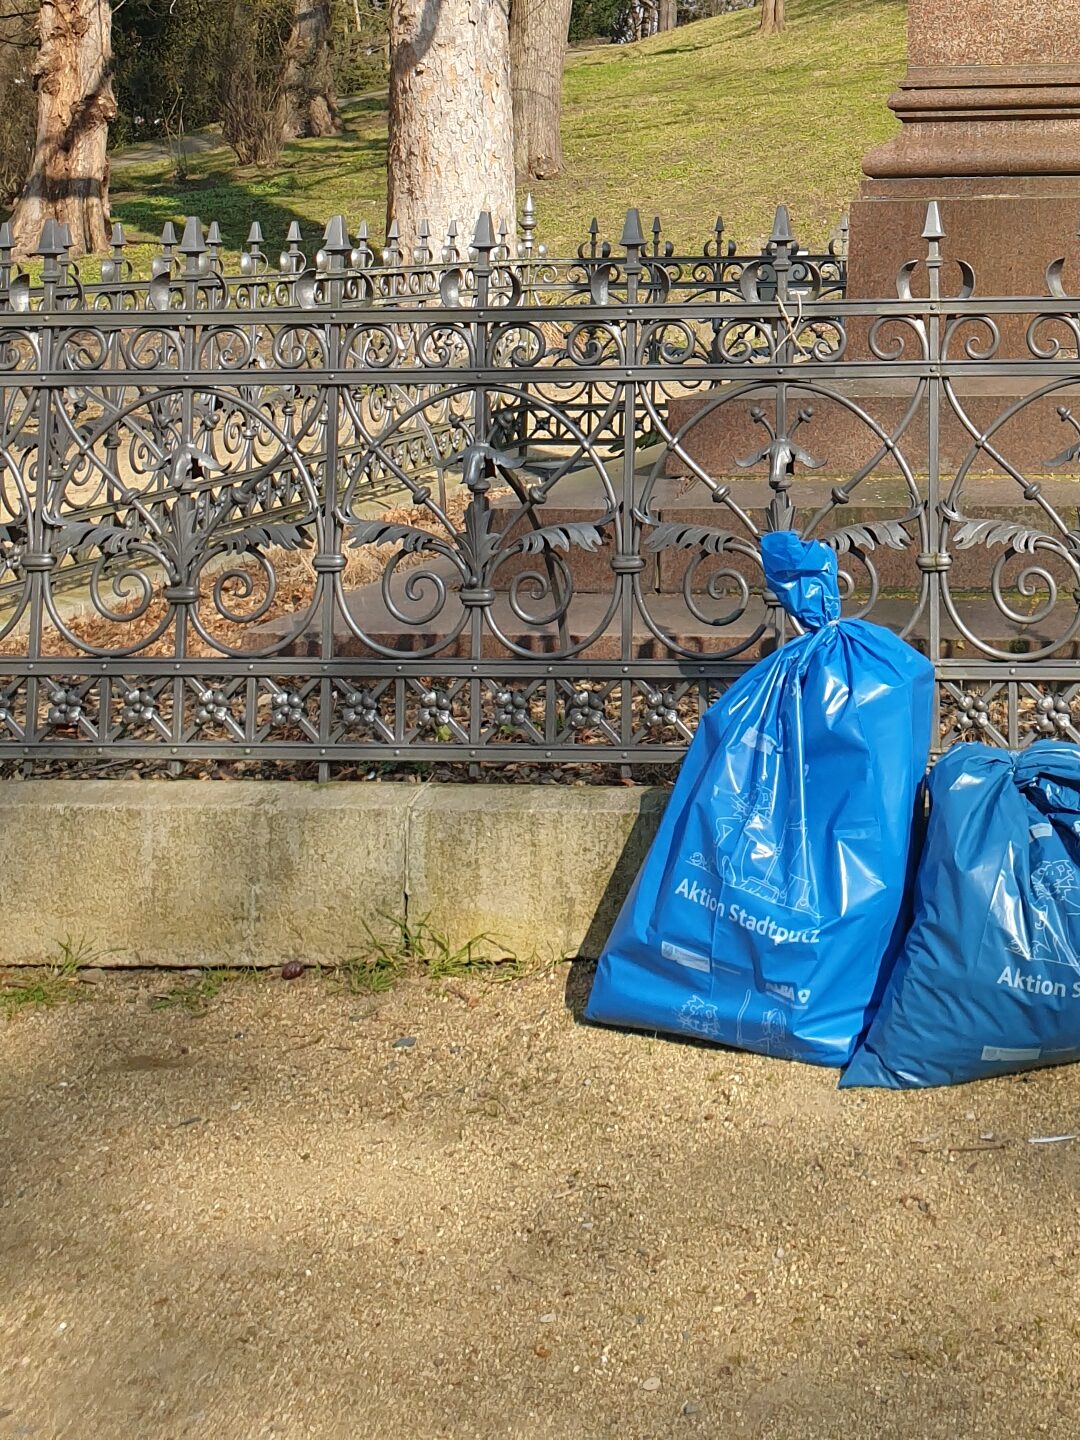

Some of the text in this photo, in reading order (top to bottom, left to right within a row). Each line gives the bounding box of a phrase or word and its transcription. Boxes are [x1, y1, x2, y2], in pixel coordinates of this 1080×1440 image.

[675, 878, 821, 946] Aktion Stadtputz
[997, 965, 1066, 998] Aktion
